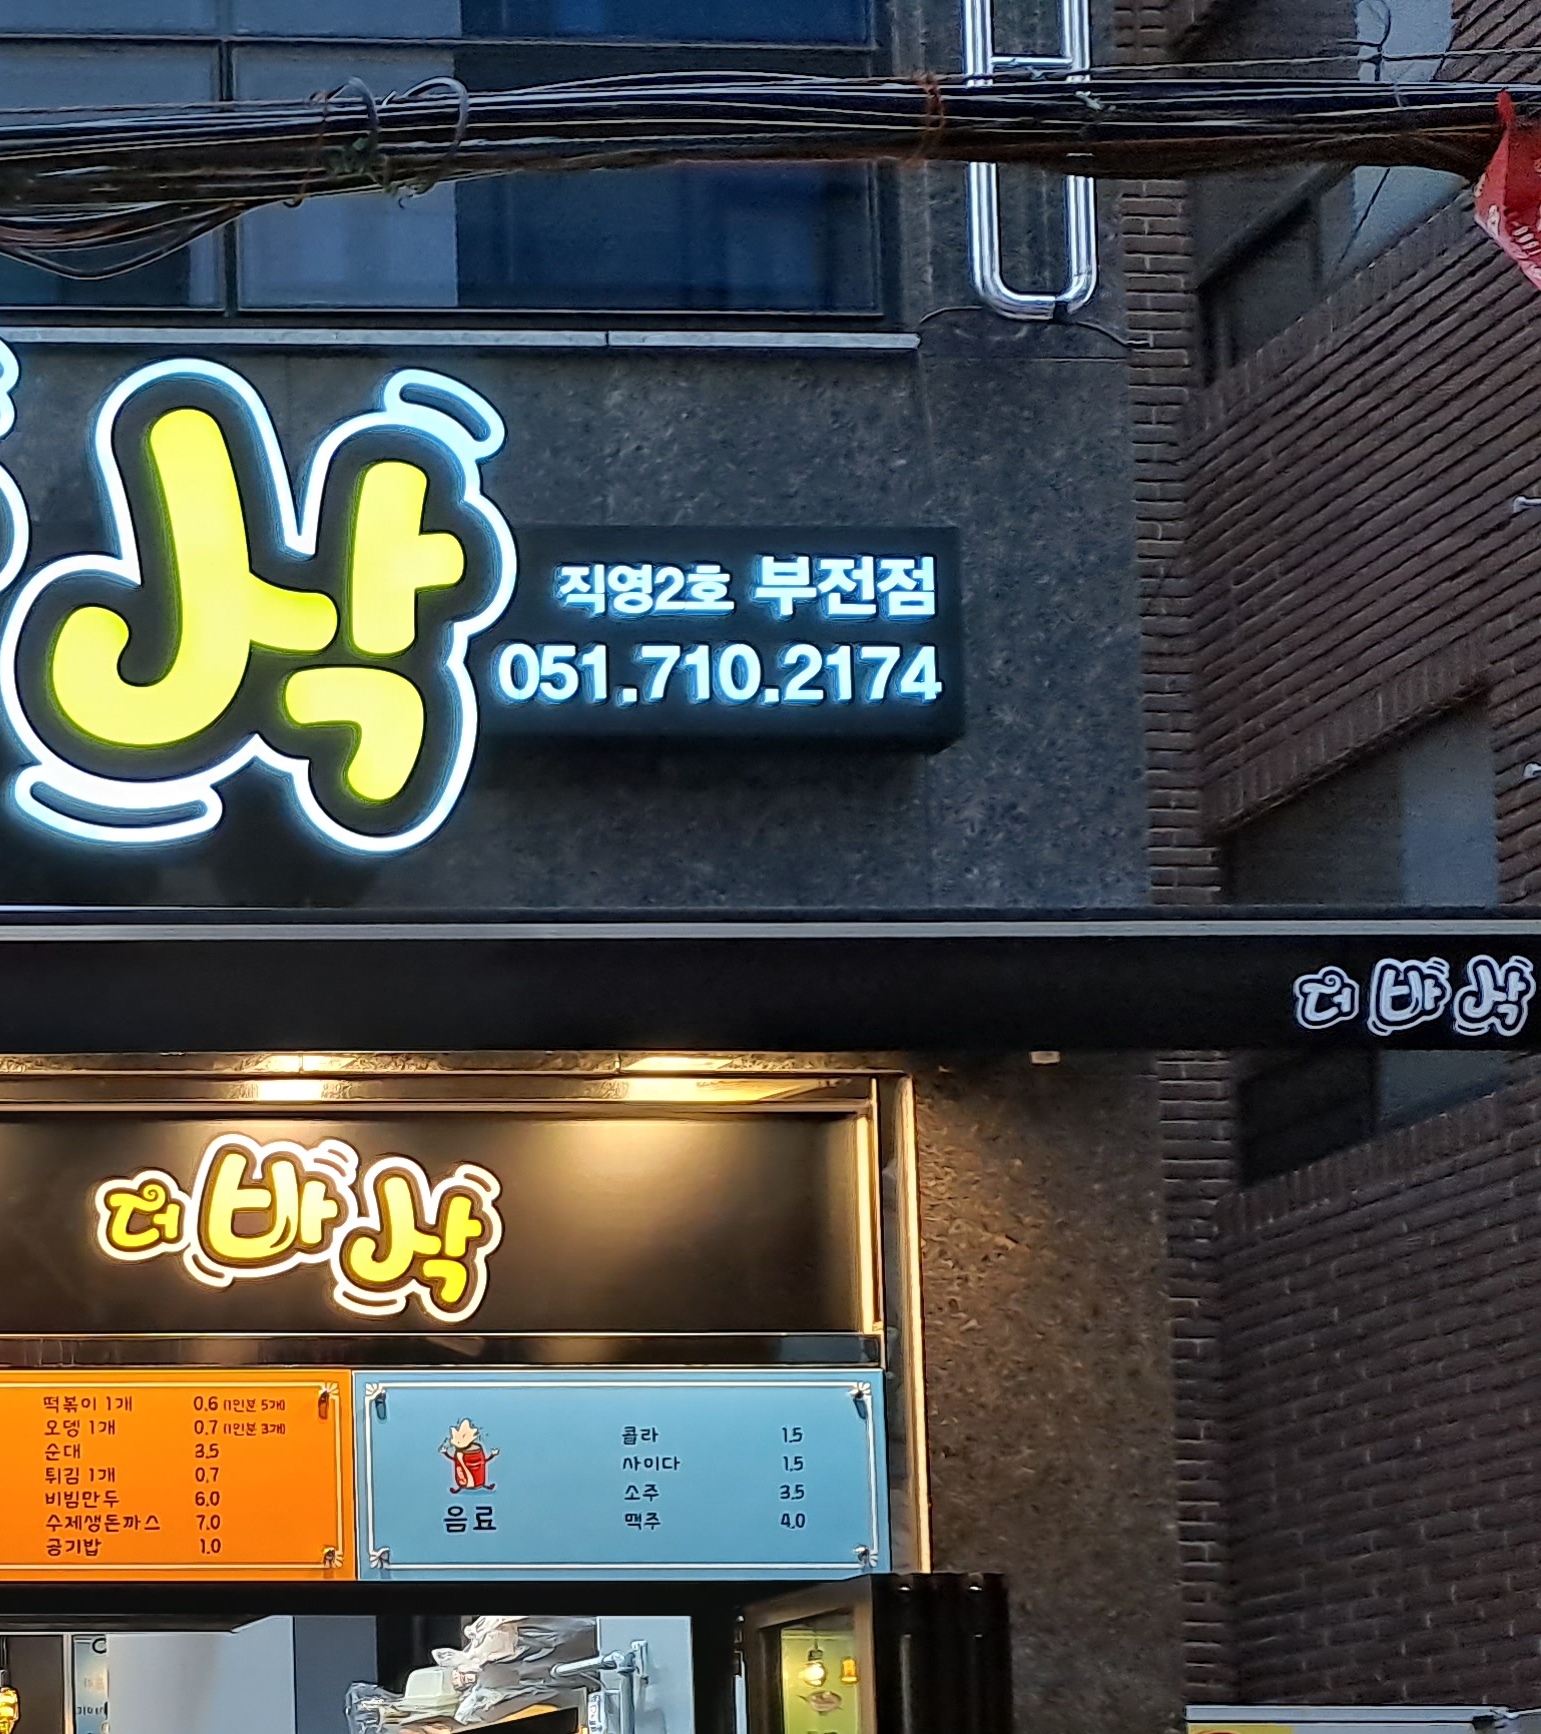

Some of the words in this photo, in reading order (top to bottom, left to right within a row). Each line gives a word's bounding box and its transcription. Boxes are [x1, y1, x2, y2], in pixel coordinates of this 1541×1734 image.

[557, 562, 736, 617] 직영2호
[753, 554, 937, 618] 부전점
[495, 642, 944, 703] 051.710.2174
[1293, 965, 1360, 1030] 더
[1366, 955, 1537, 1037] 바삭
[109, 1183, 181, 1248] 더
[207, 1152, 485, 1303] 바삭
[43, 1395, 97, 1414] 떡볶이
[106, 1395, 133, 1412] 1개
[193, 1395, 219, 1412] 0.6
[44, 1419, 80, 1438] 오뎅
[89, 1419, 116, 1435] 1개
[194, 1419, 219, 1436] 0.7
[621, 1426, 659, 1446] 콜라
[782, 1427, 803, 1444] 1.5
[44, 1443, 81, 1462] 순대
[195, 1443, 220, 1460] 3.5
[622, 1456, 681, 1472] 사이다
[783, 1455, 804, 1472] 1.5
[44, 1467, 80, 1486] 튀김
[89, 1467, 116, 1483] 1개
[195, 1466, 220, 1484] 0.7
[44, 1490, 120, 1509] 비빔만두
[194, 1490, 221, 1507] 6.0
[624, 1483, 660, 1502] 소주
[779, 1484, 805, 1501] 3.5
[45, 1514, 161, 1533] 수제생돈까스
[195, 1514, 221, 1531] 7.0
[443, 1505, 497, 1533] 음료
[624, 1512, 661, 1531] 맥주
[46, 1538, 102, 1557] 공기밥
[200, 1538, 222, 1555] 1.0
